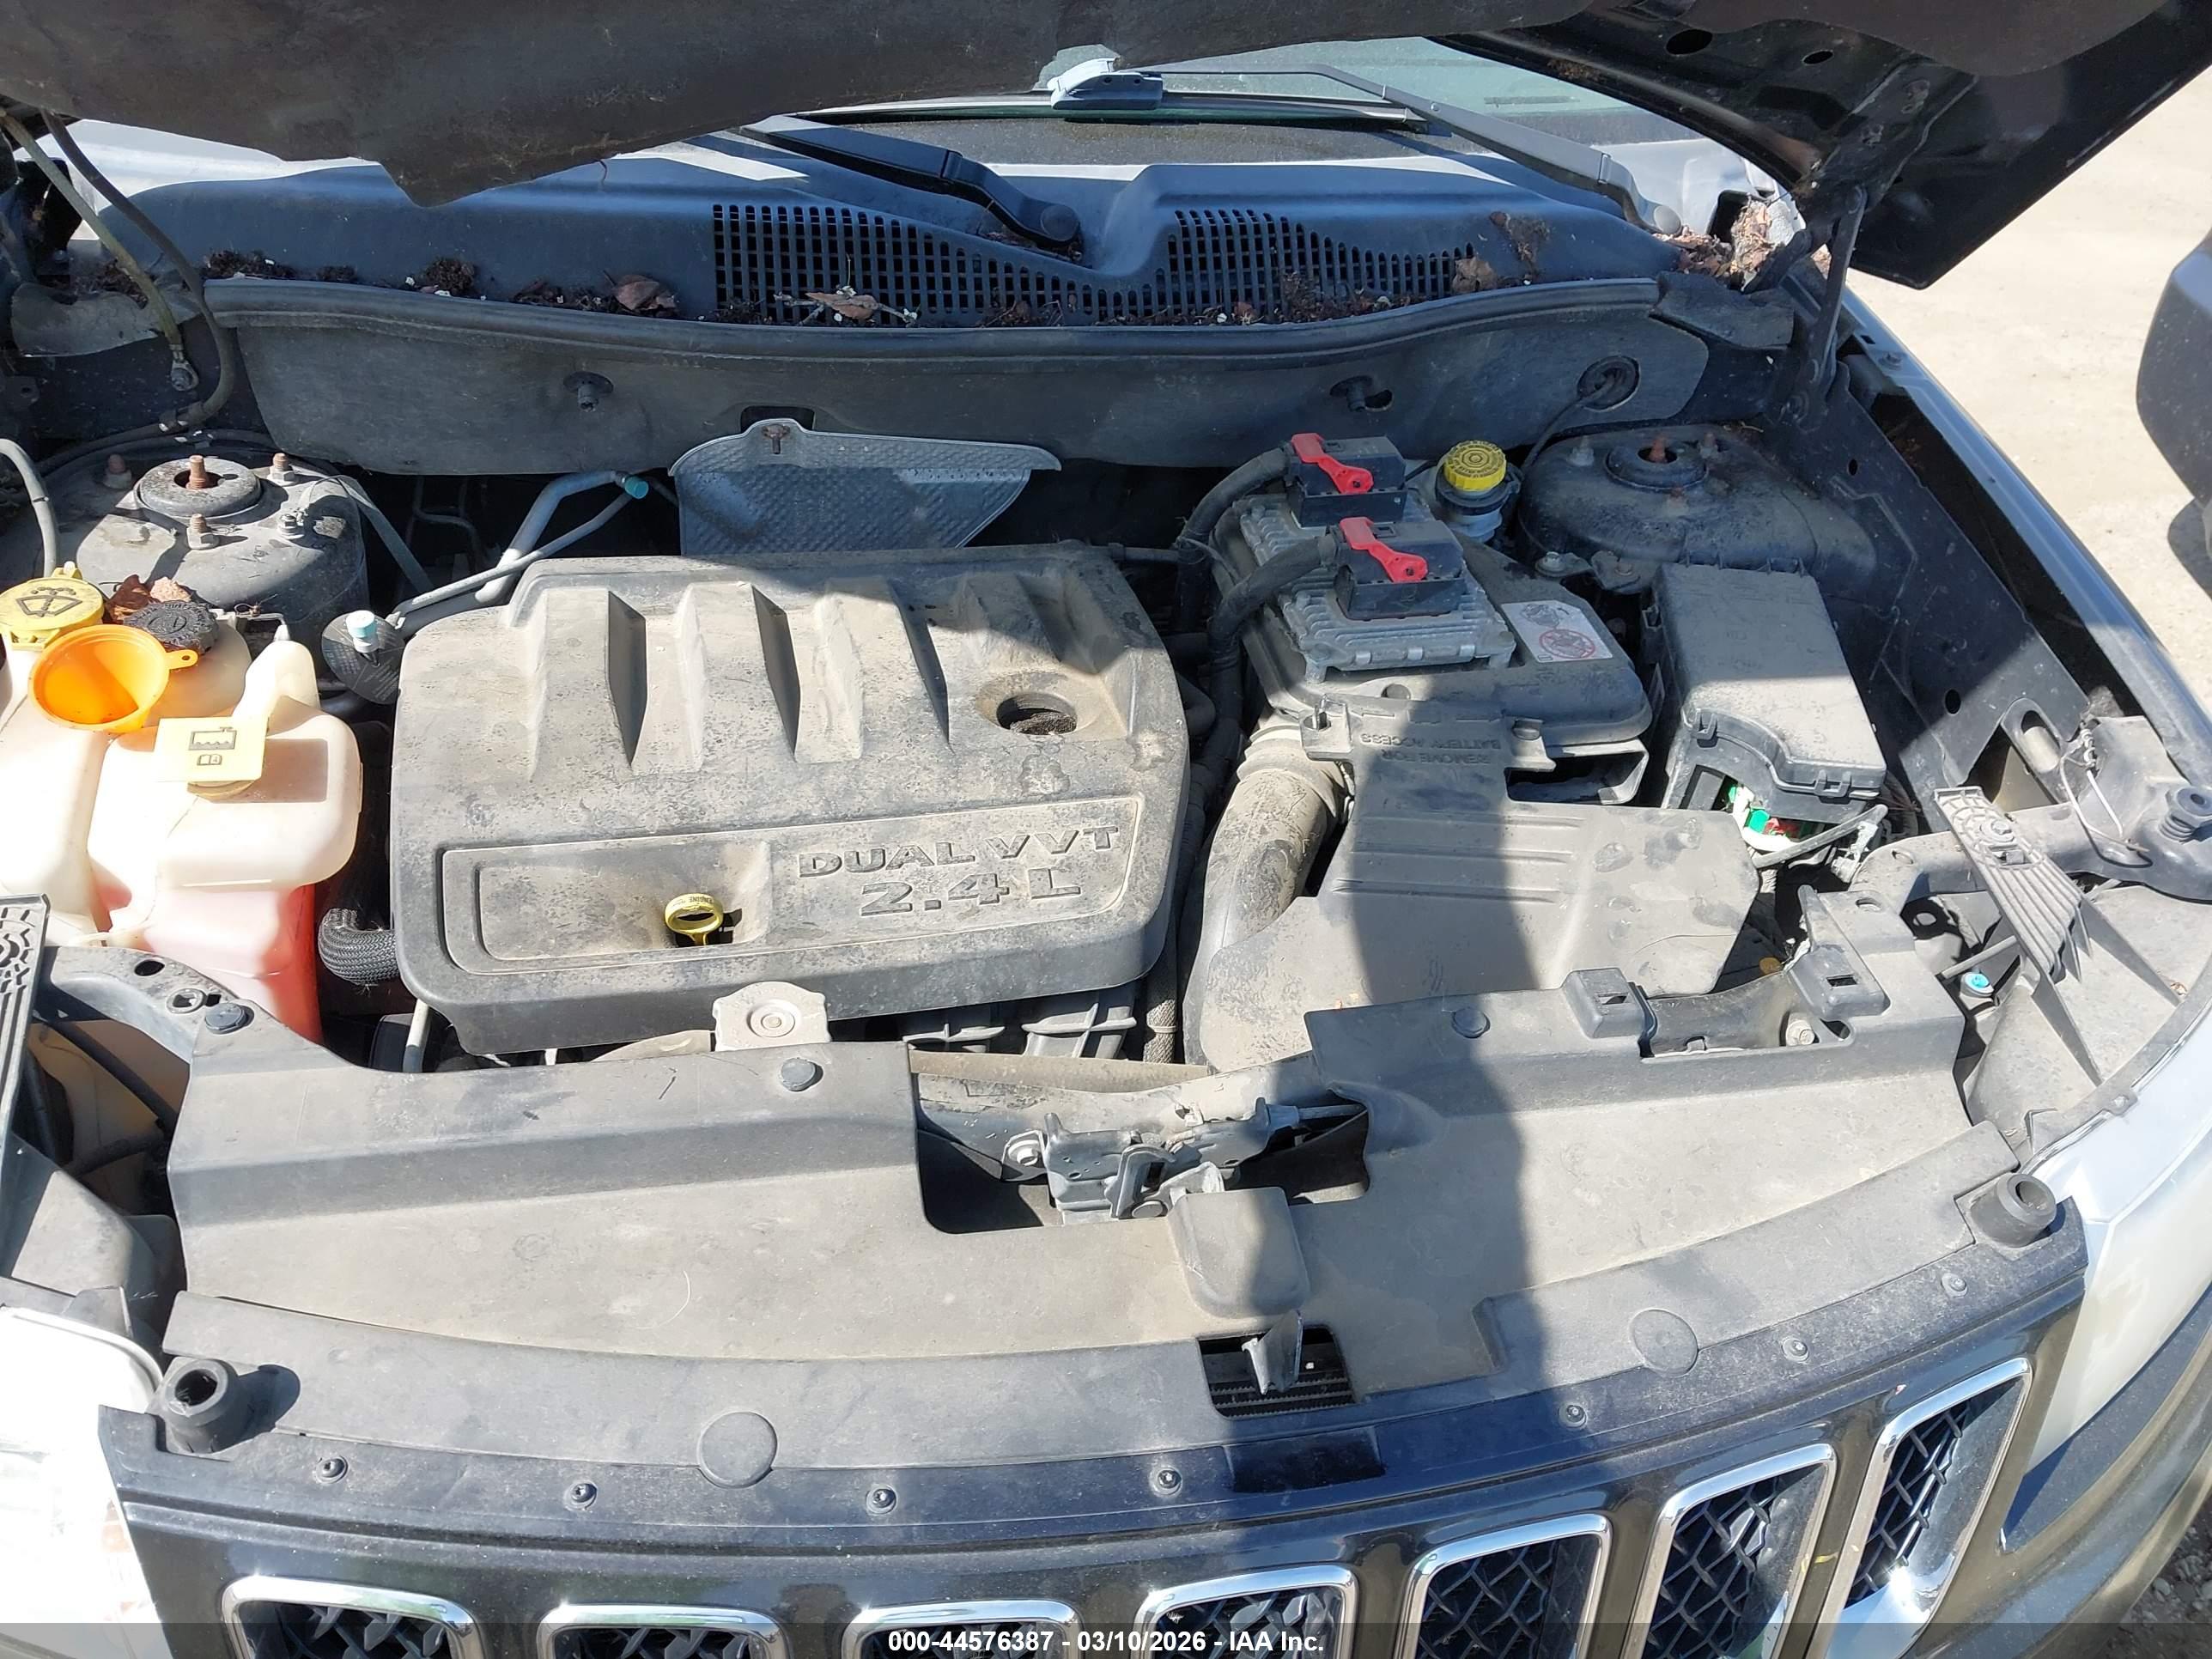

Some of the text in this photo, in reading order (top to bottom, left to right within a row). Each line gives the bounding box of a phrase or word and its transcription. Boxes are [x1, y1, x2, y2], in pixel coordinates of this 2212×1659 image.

[1359, 732, 1502, 750] BATTERY ACCESS
[1380, 749, 1491, 764] REMOVE FOR
[798, 825, 1119, 878] DUAL VVT
